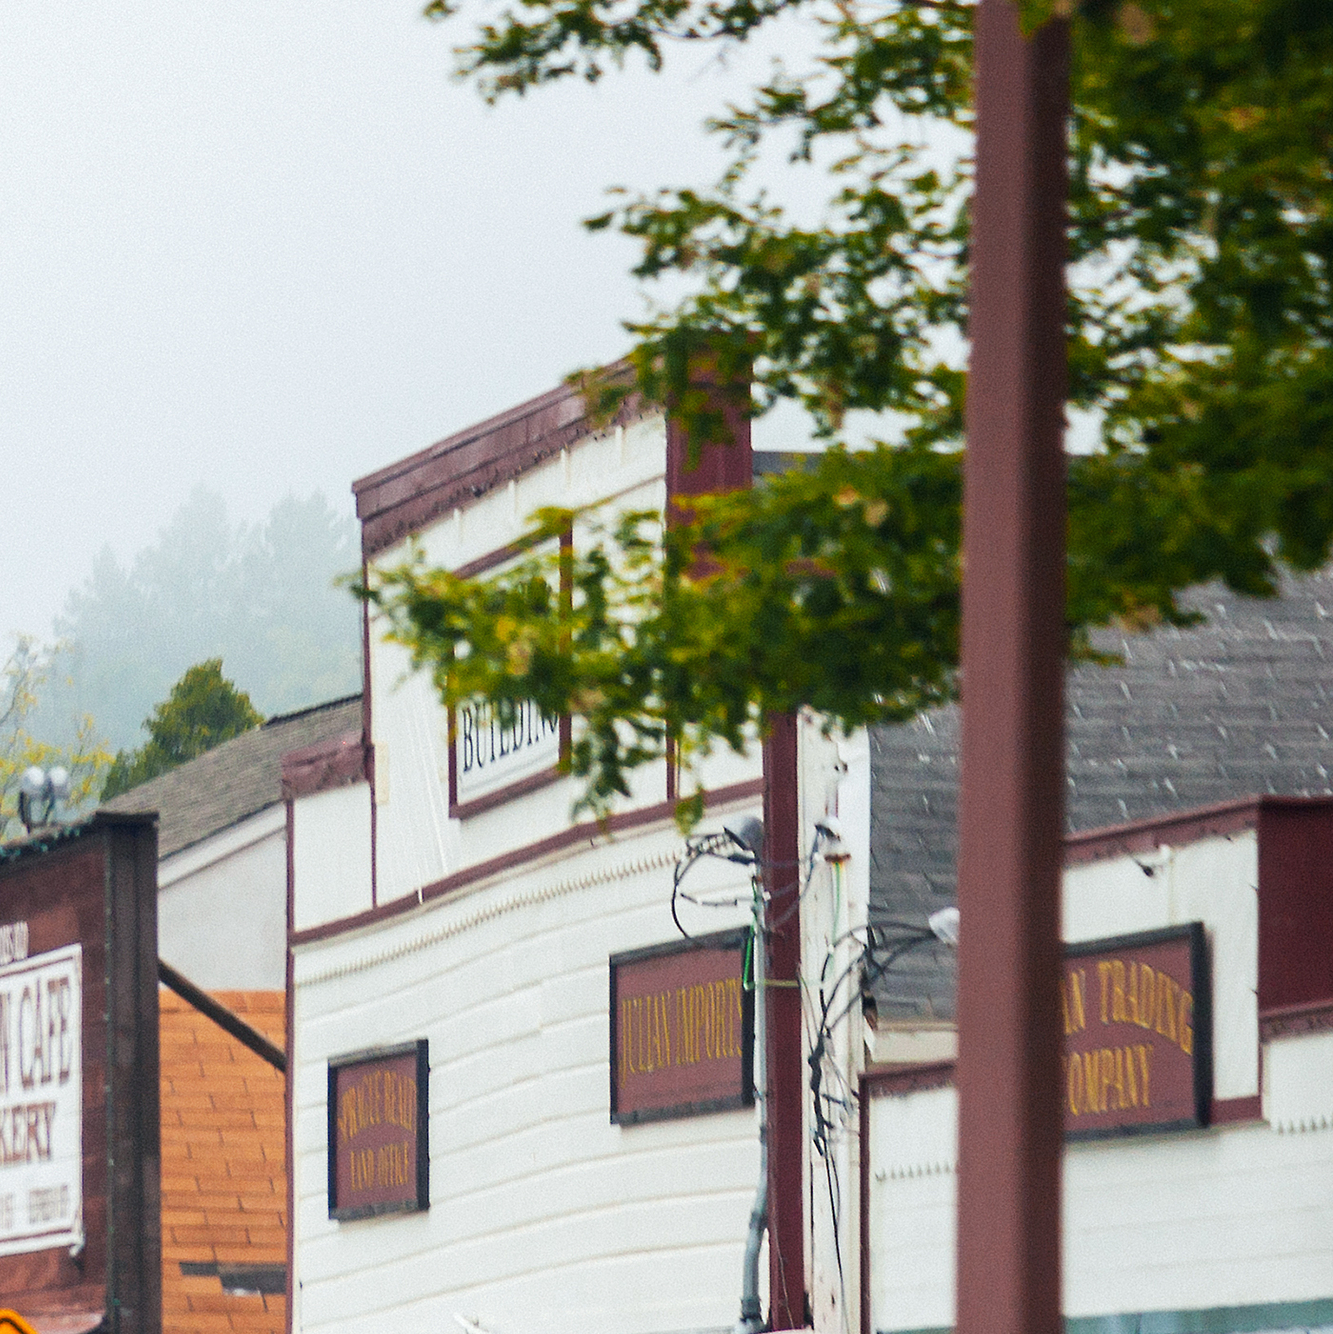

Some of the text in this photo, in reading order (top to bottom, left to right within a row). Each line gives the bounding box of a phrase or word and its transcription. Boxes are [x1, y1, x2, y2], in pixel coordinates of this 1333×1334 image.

[619, 989, 671, 1089] JULIAN
[1098, 960, 1194, 1056] TRADING
[1063, 1044, 1154, 1116] OMPANY
